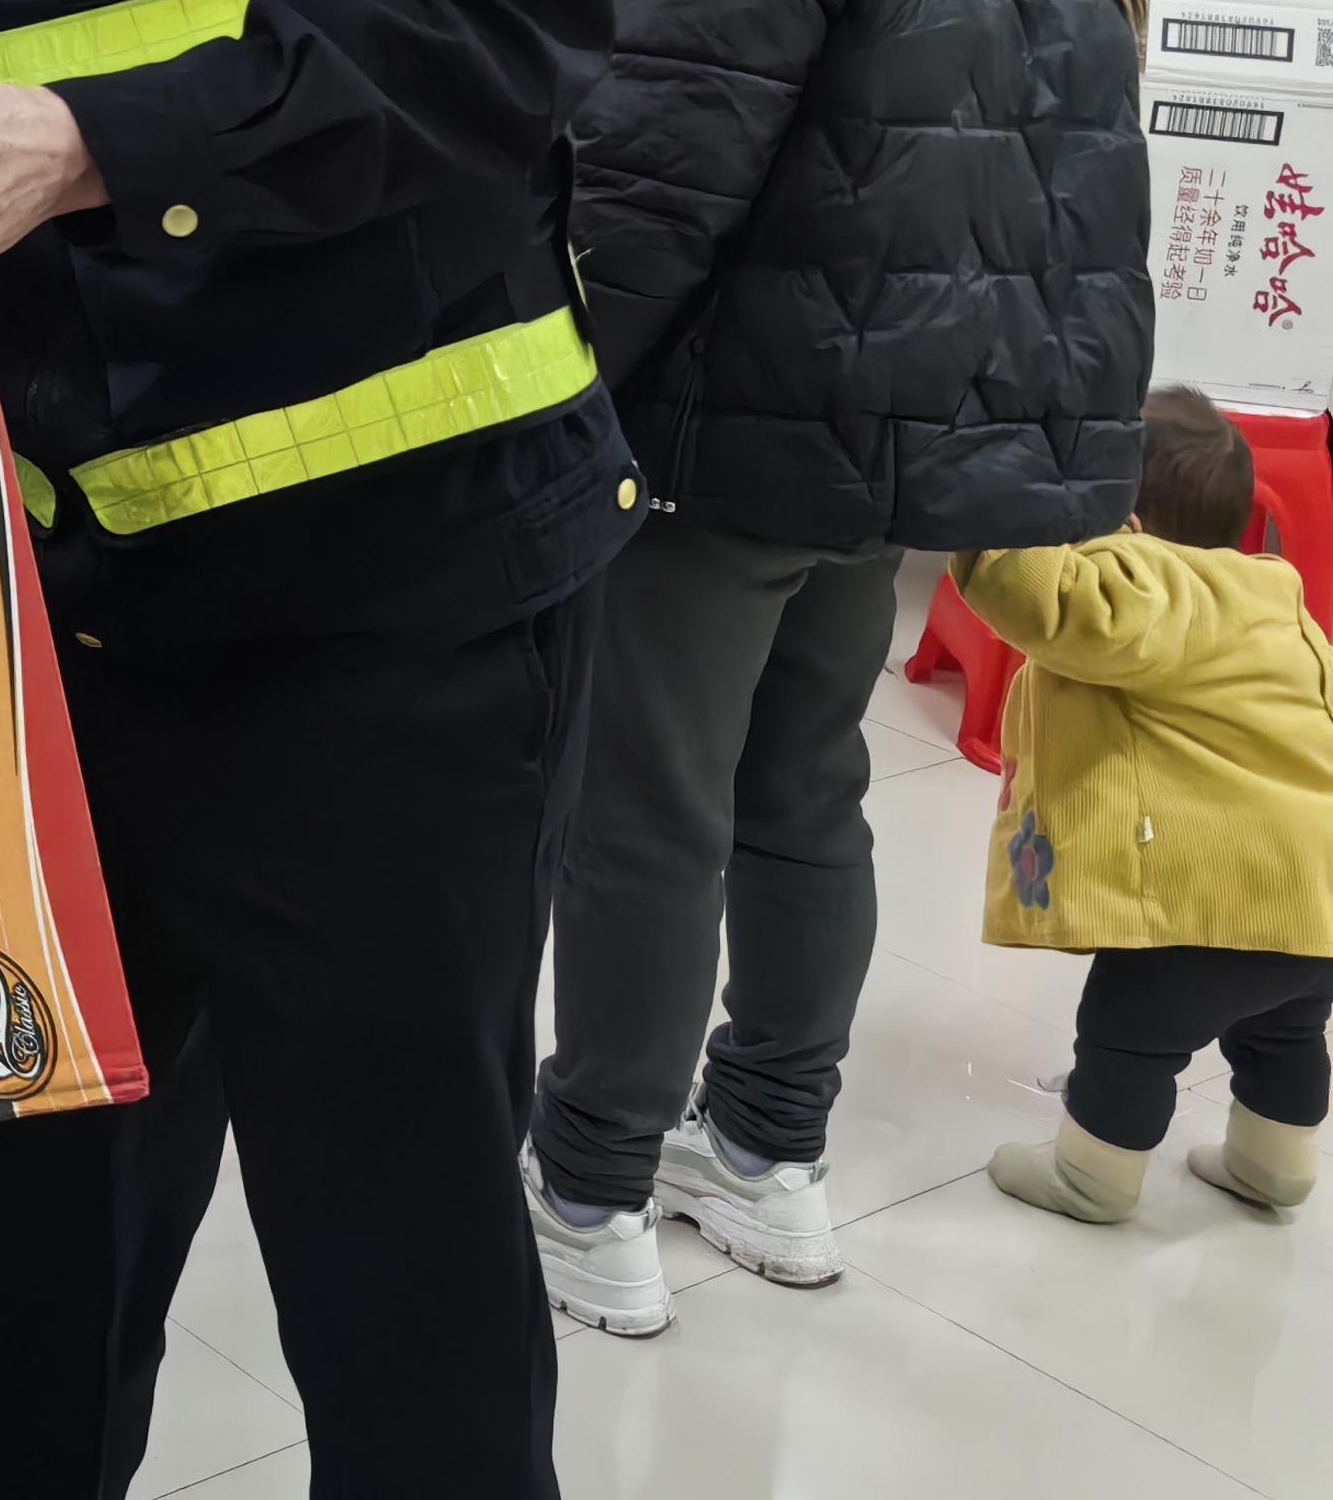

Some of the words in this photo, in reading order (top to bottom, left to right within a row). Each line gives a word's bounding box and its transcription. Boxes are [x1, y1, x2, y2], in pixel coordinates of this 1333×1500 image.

[1159, 165, 1204, 301] 质量经得起考验
[1186, 167, 1229, 302] 二十余年如一日
[1223, 203, 1250, 278] 饮用纯净水
[1253, 162, 1326, 328] 娃哈哈
[10, 984, 41, 1064] Classic
